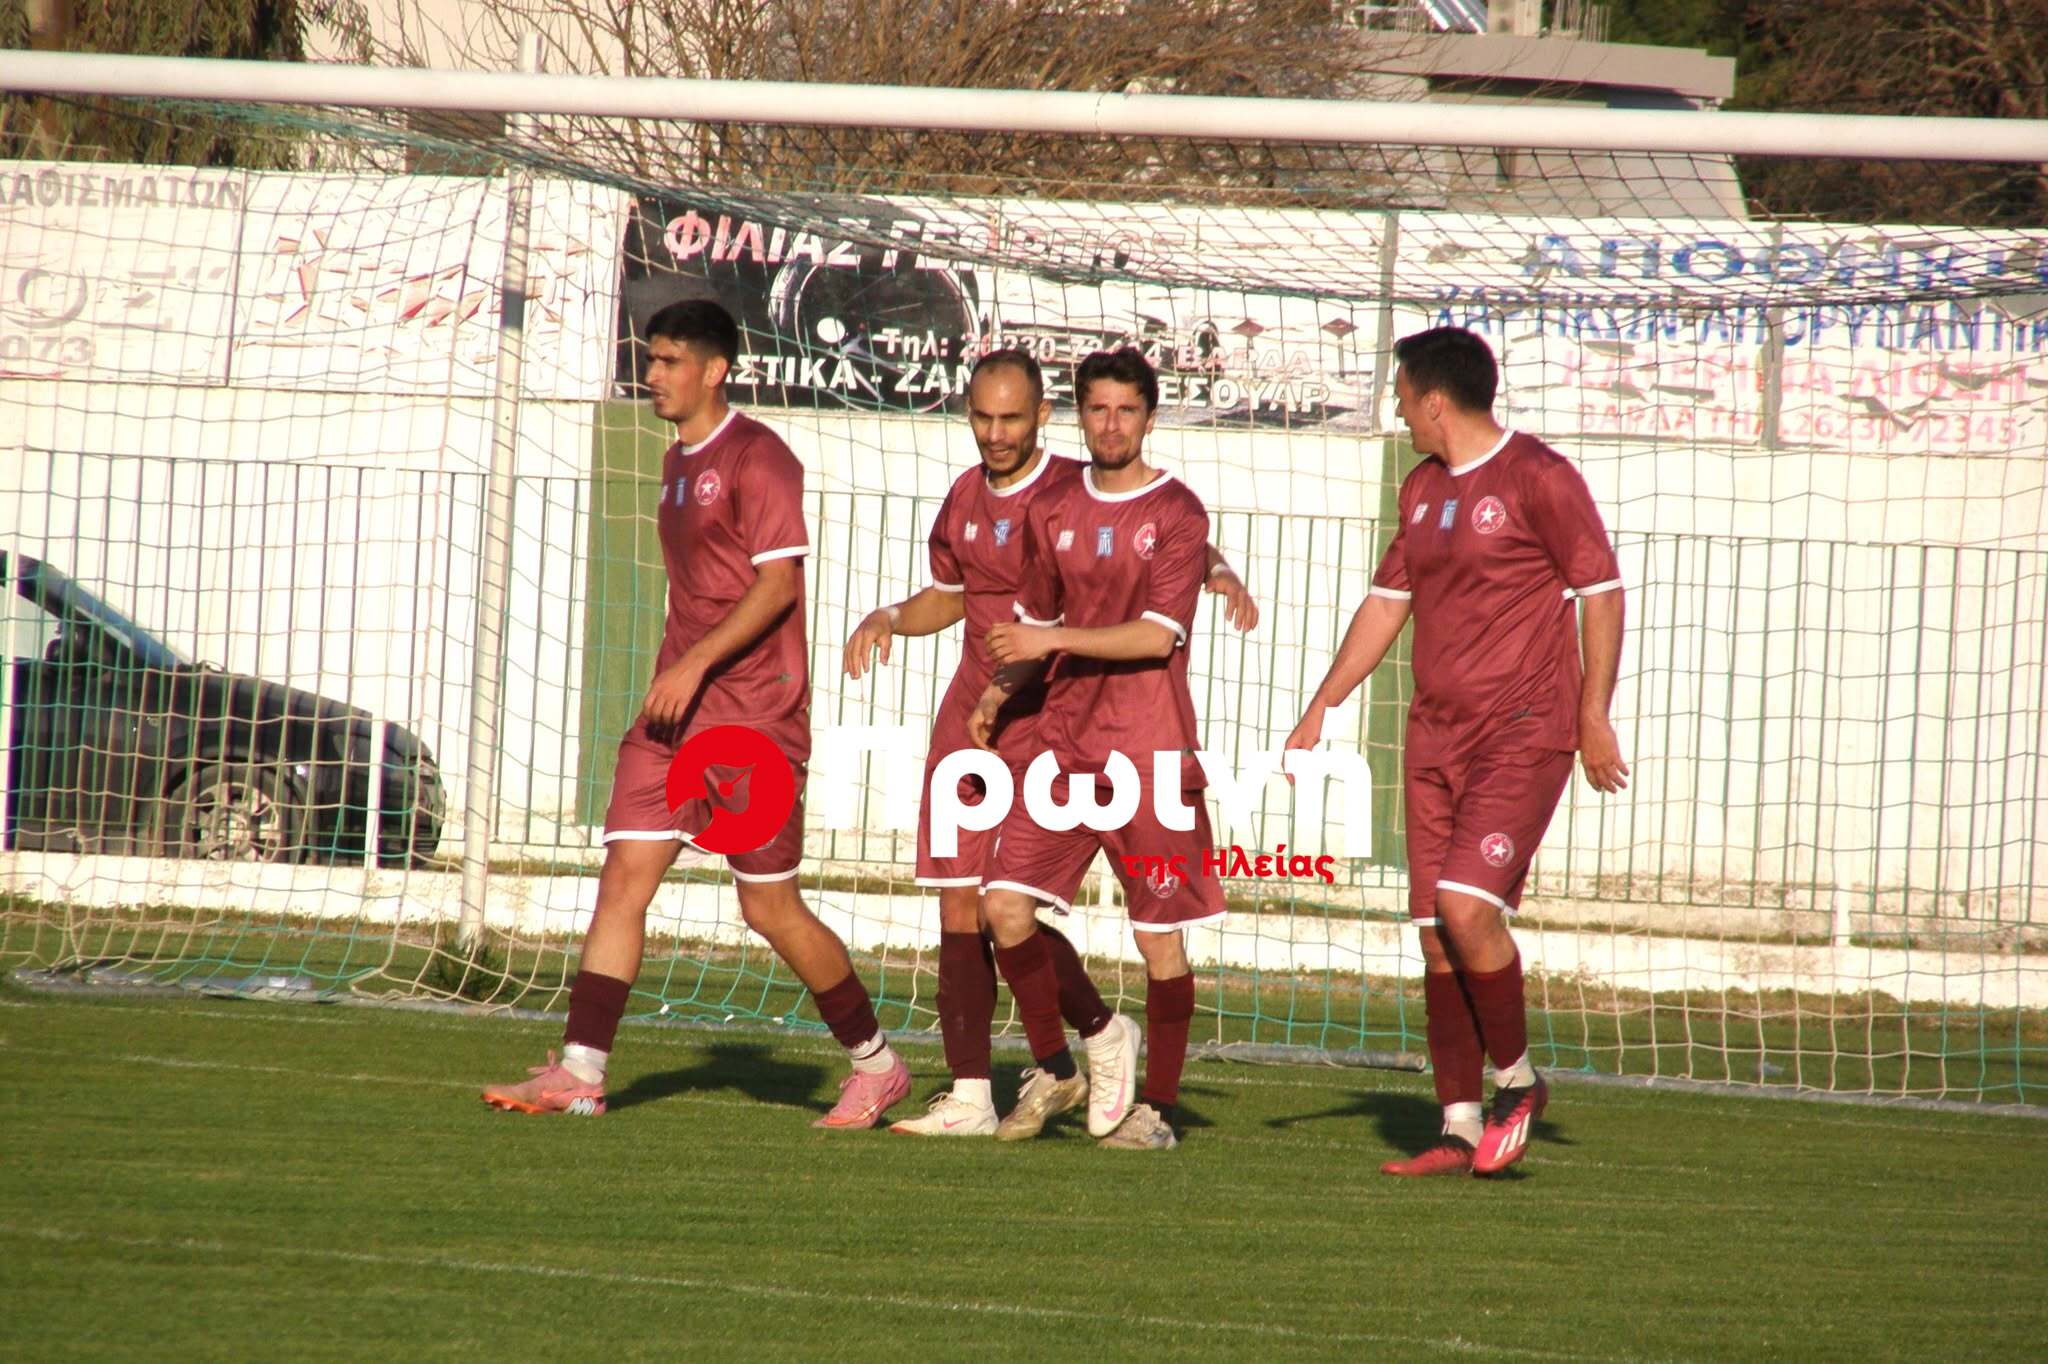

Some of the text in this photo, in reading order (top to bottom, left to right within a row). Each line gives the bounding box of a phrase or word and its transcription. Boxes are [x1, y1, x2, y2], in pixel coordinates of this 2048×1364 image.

[0, 168, 242, 209] ΑΘΙΣΜΑΤΩΝ
[726, 354, 859, 390] ΣΤΙΚΑ
[1158, 375, 1331, 414] ΕΣΟΥΑΡ
